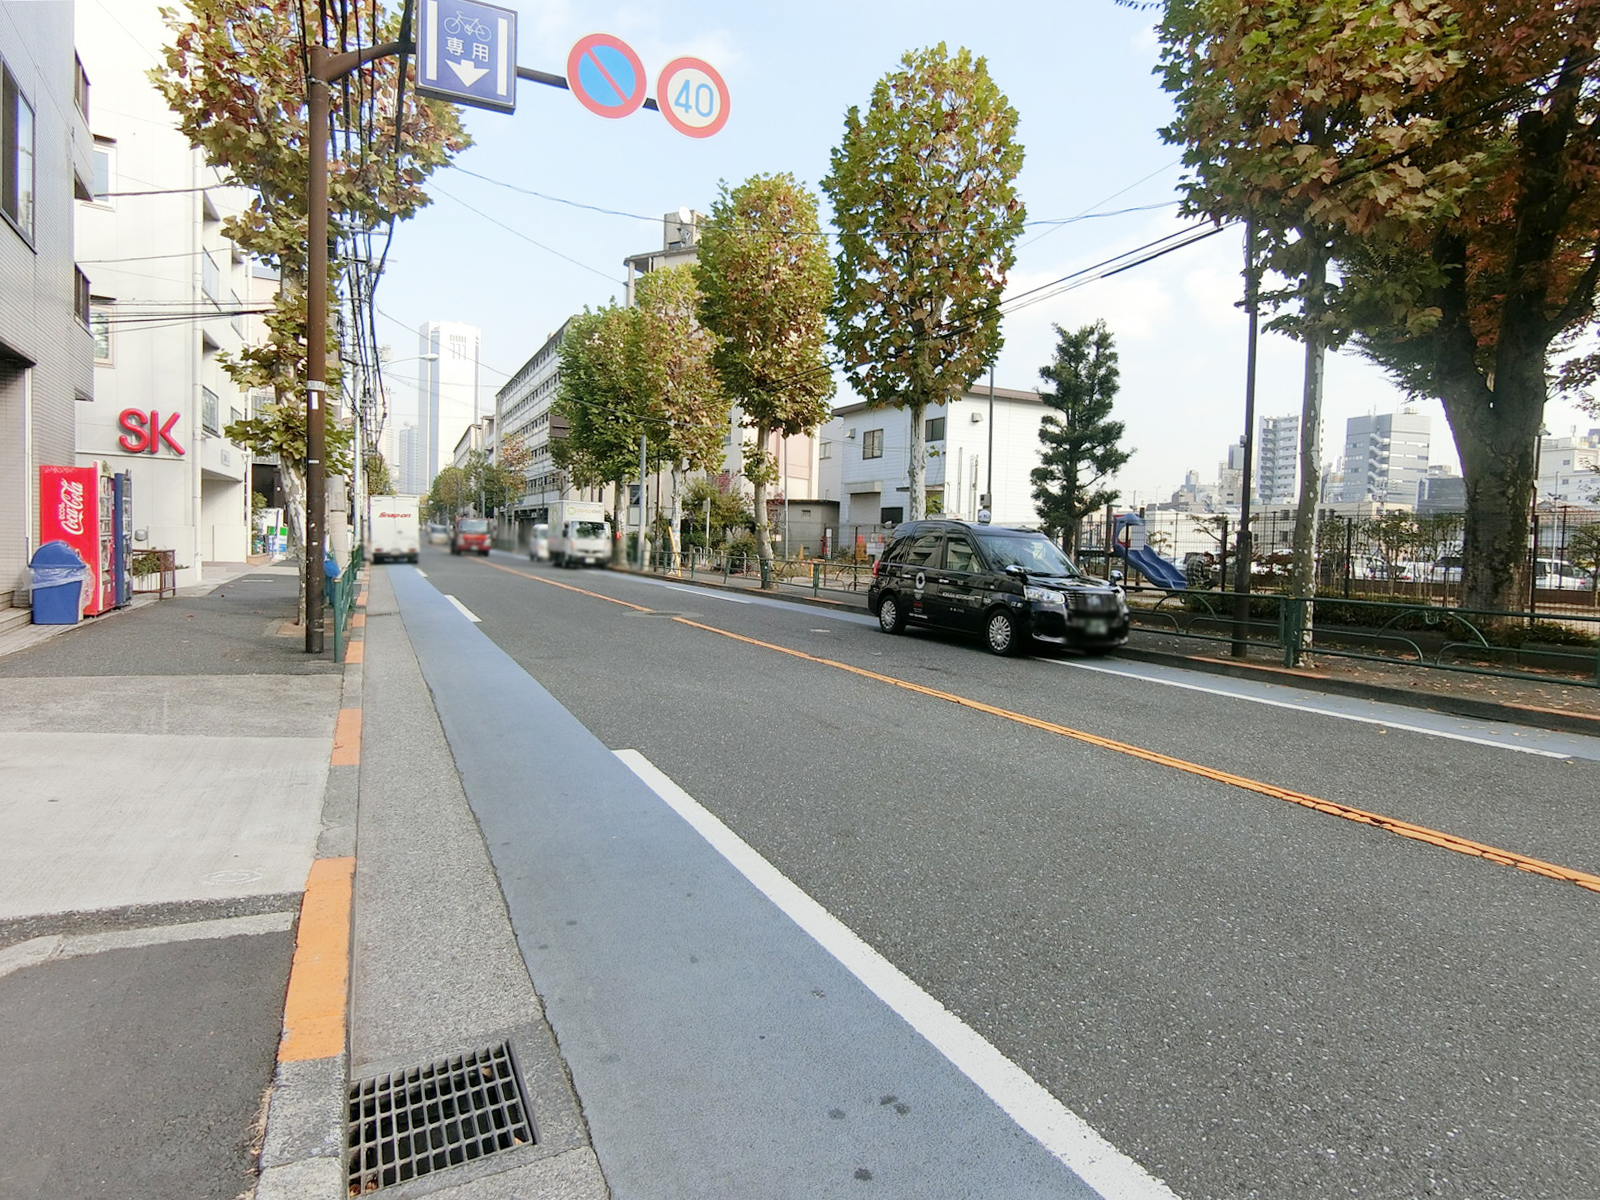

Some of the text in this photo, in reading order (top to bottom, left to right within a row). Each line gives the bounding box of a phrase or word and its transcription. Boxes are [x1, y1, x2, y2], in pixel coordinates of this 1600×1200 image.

[445, 36, 490, 63] 専用
[673, 79, 714, 118] 40
[118, 407, 186, 456] SK
[60, 477, 84, 535] Coca-Cola
[378, 511, 412, 519] Snap-on
